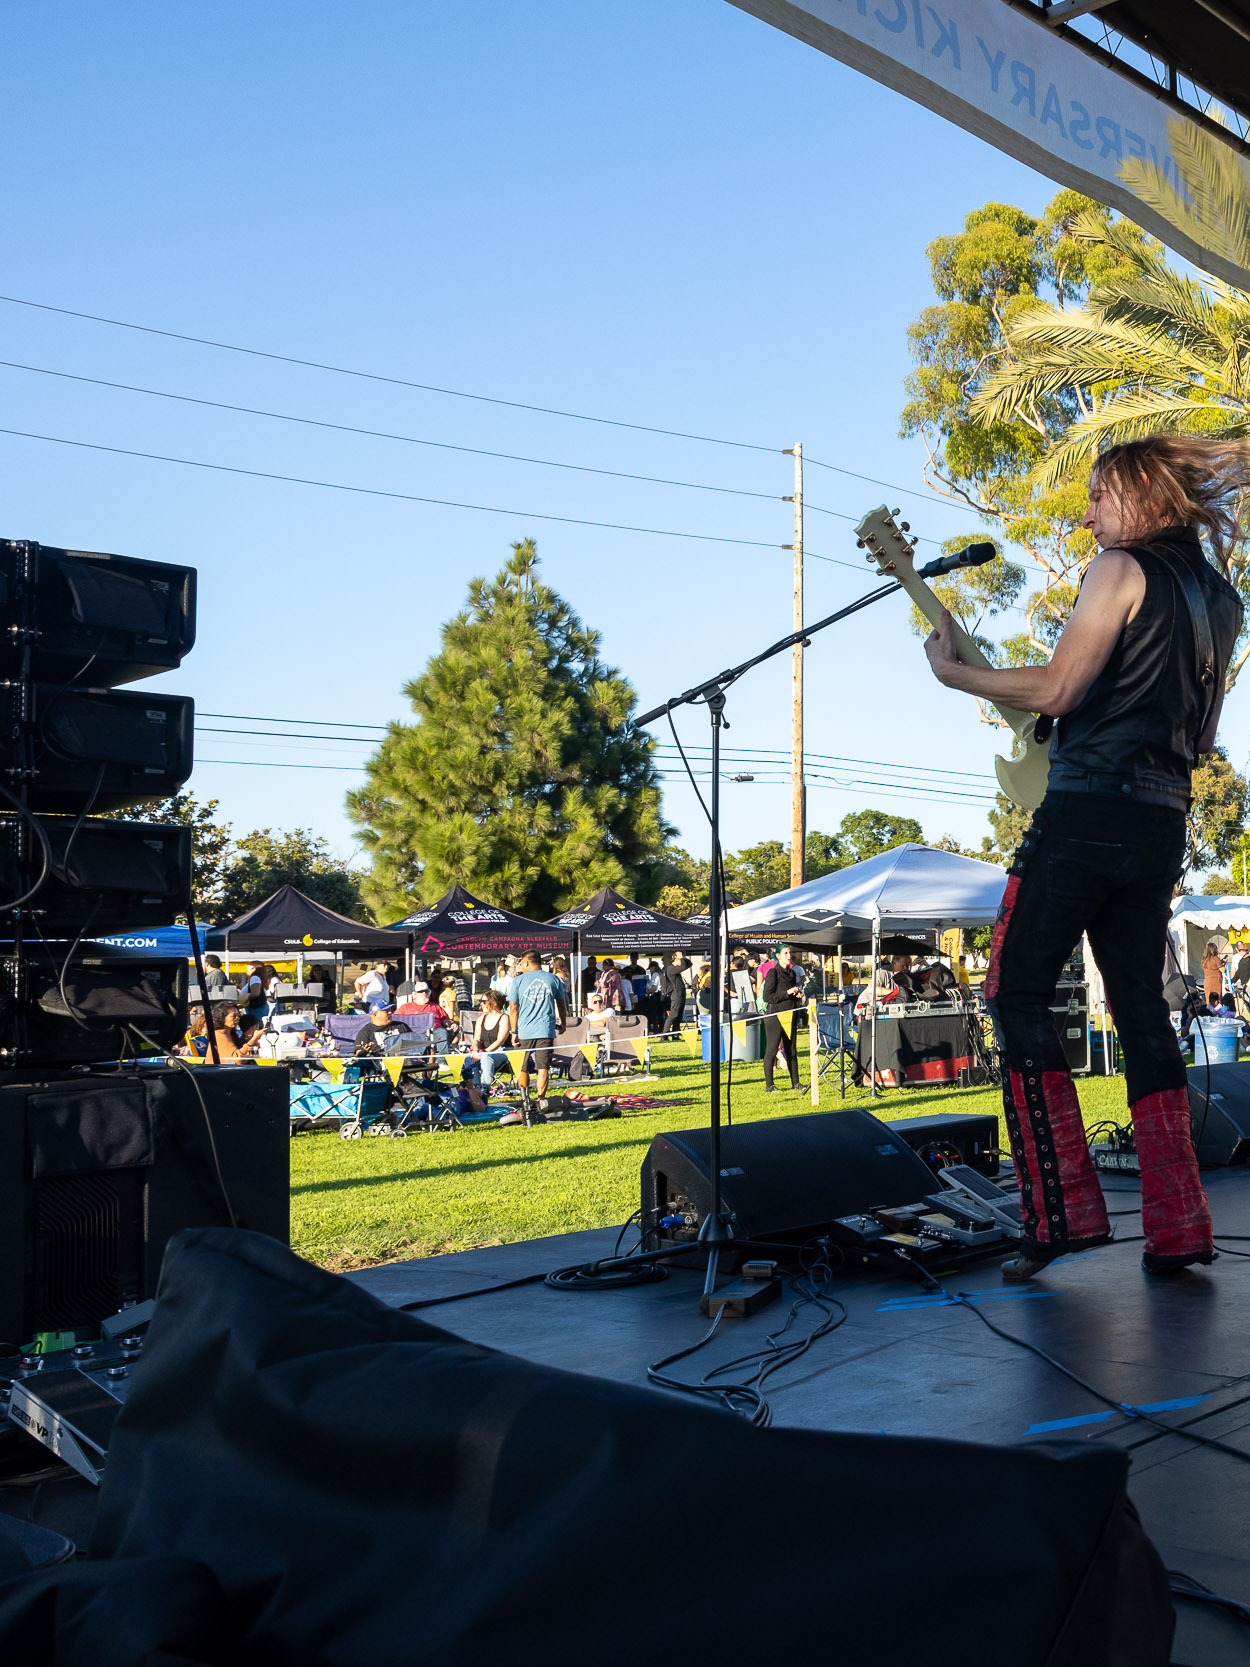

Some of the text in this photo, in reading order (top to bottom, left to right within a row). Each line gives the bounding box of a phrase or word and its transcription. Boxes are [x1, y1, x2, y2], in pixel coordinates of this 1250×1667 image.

[602, 911, 636, 919] COLLEGE
[446, 942, 515, 950] CONTEMPORARY
[536, 942, 570, 950] MUSEUM
